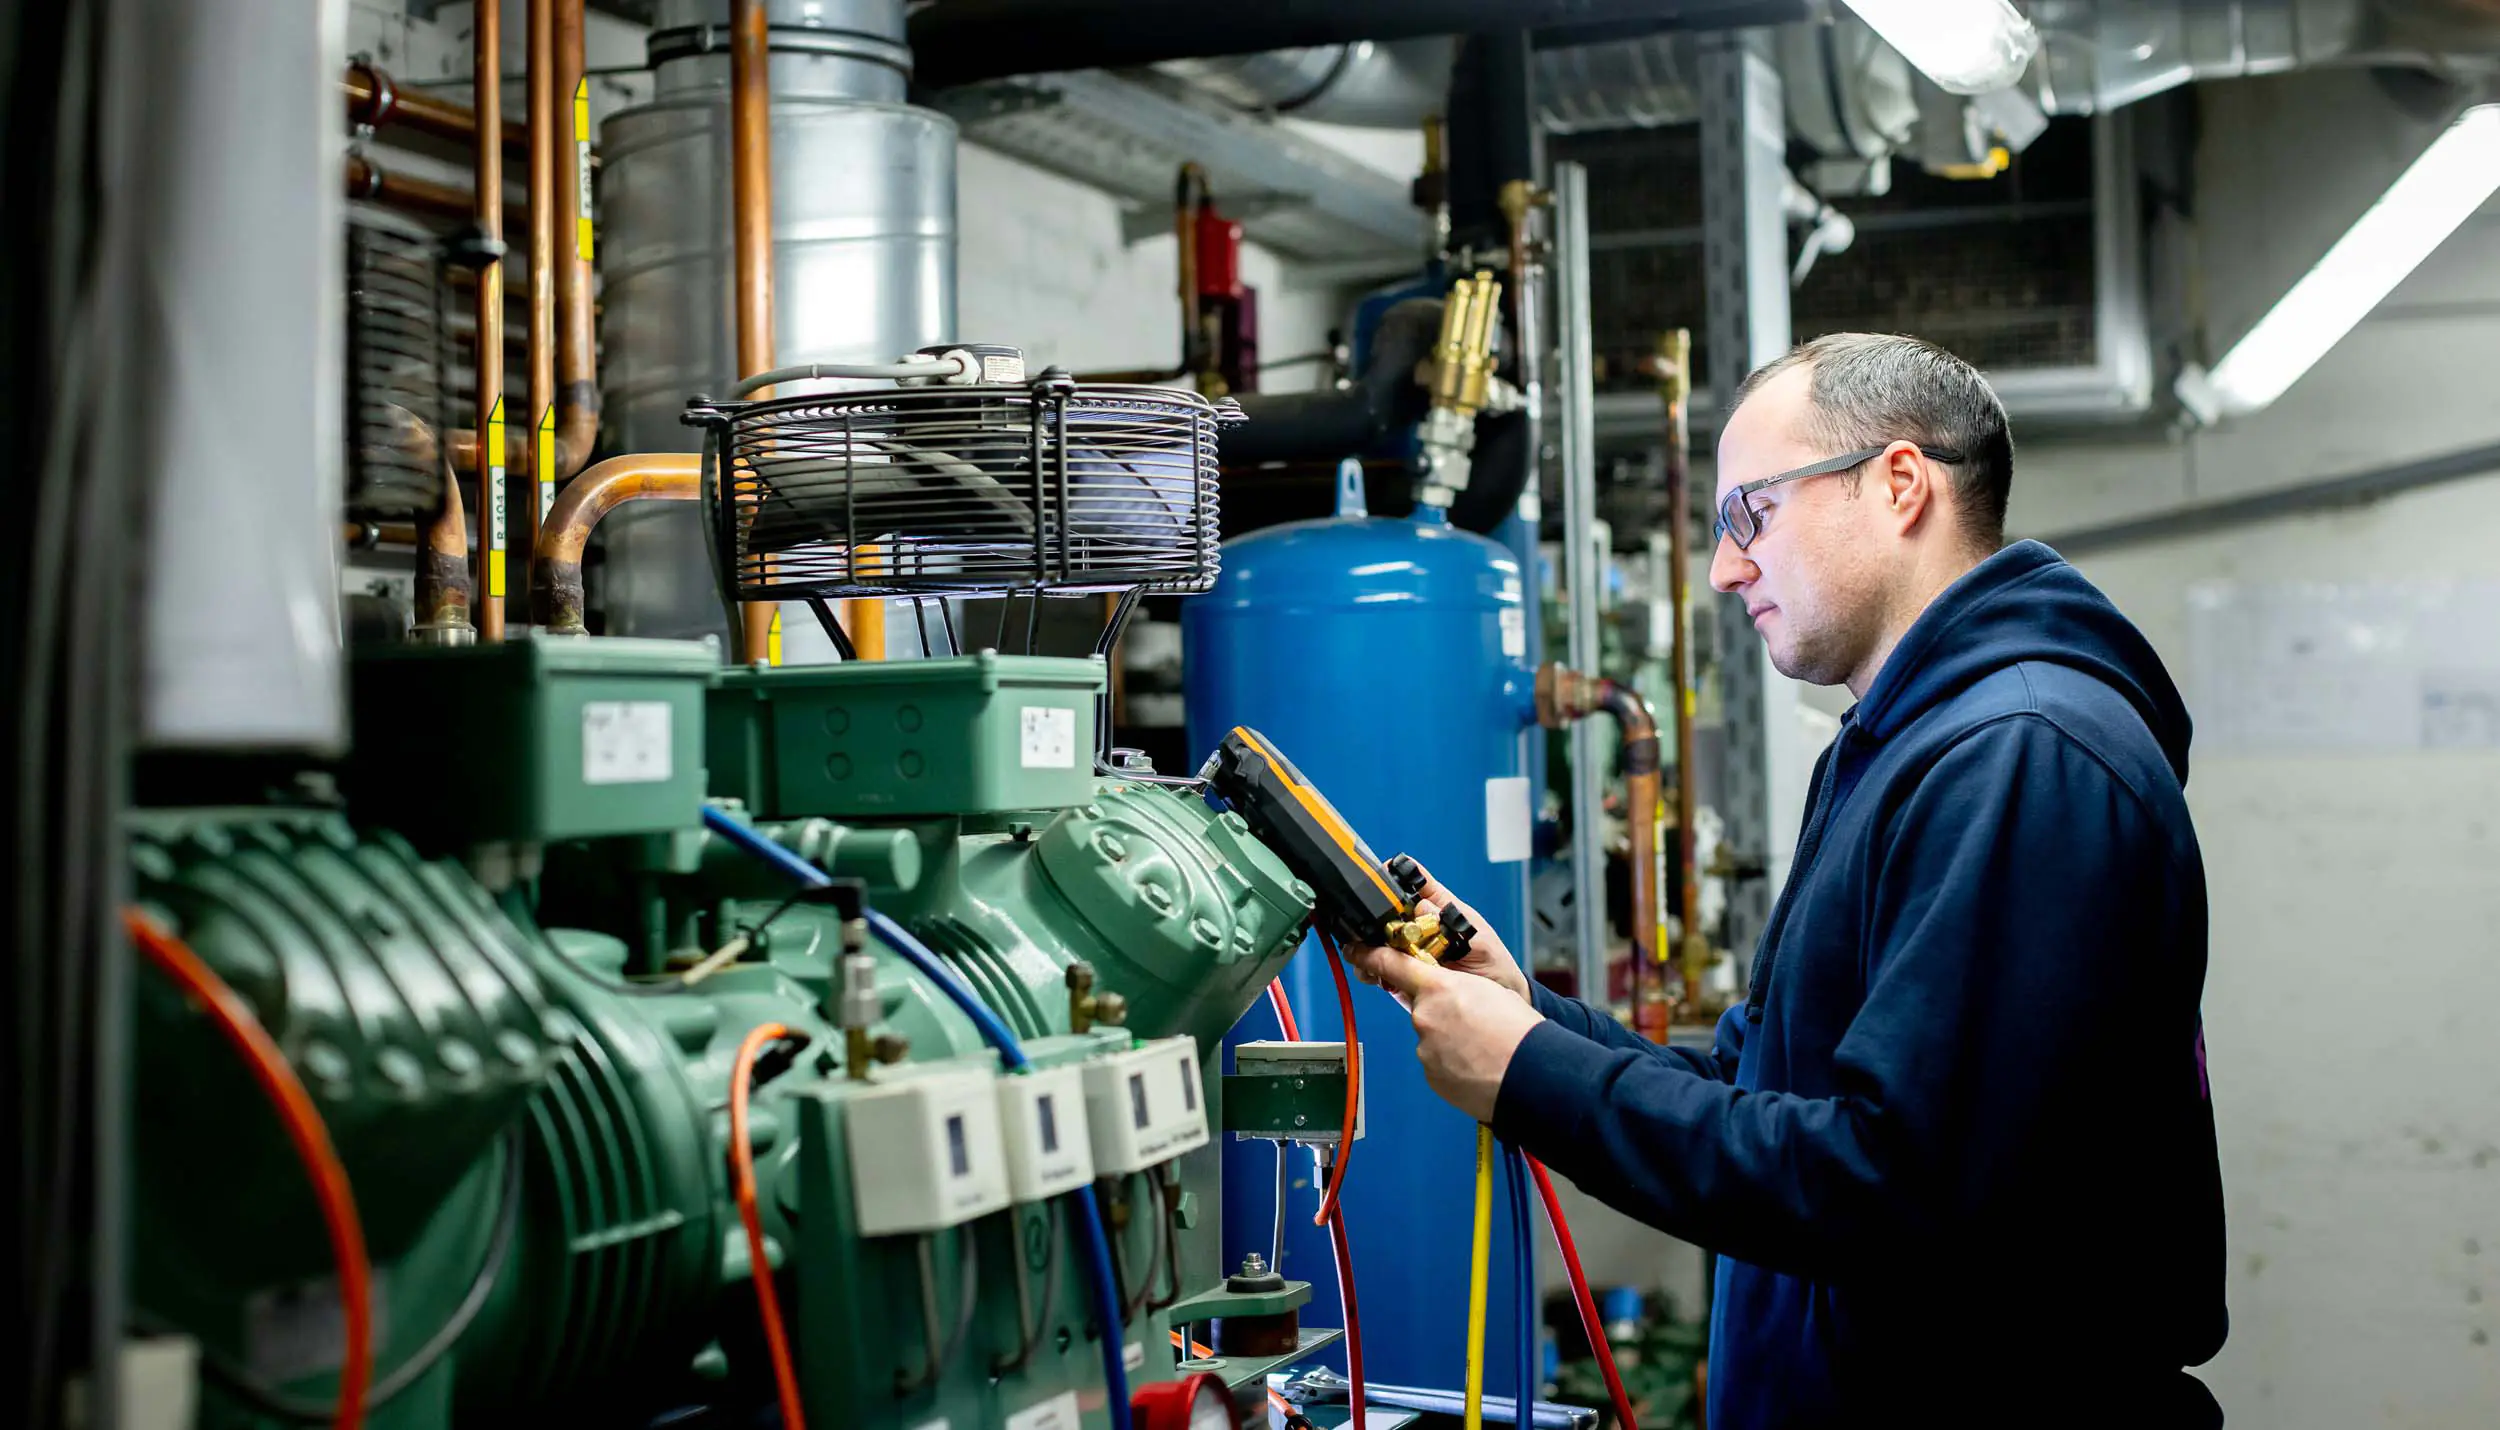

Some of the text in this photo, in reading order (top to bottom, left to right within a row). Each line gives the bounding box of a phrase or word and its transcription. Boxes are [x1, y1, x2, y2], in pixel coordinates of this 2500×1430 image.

[496, 478, 504, 540] R 404 A
